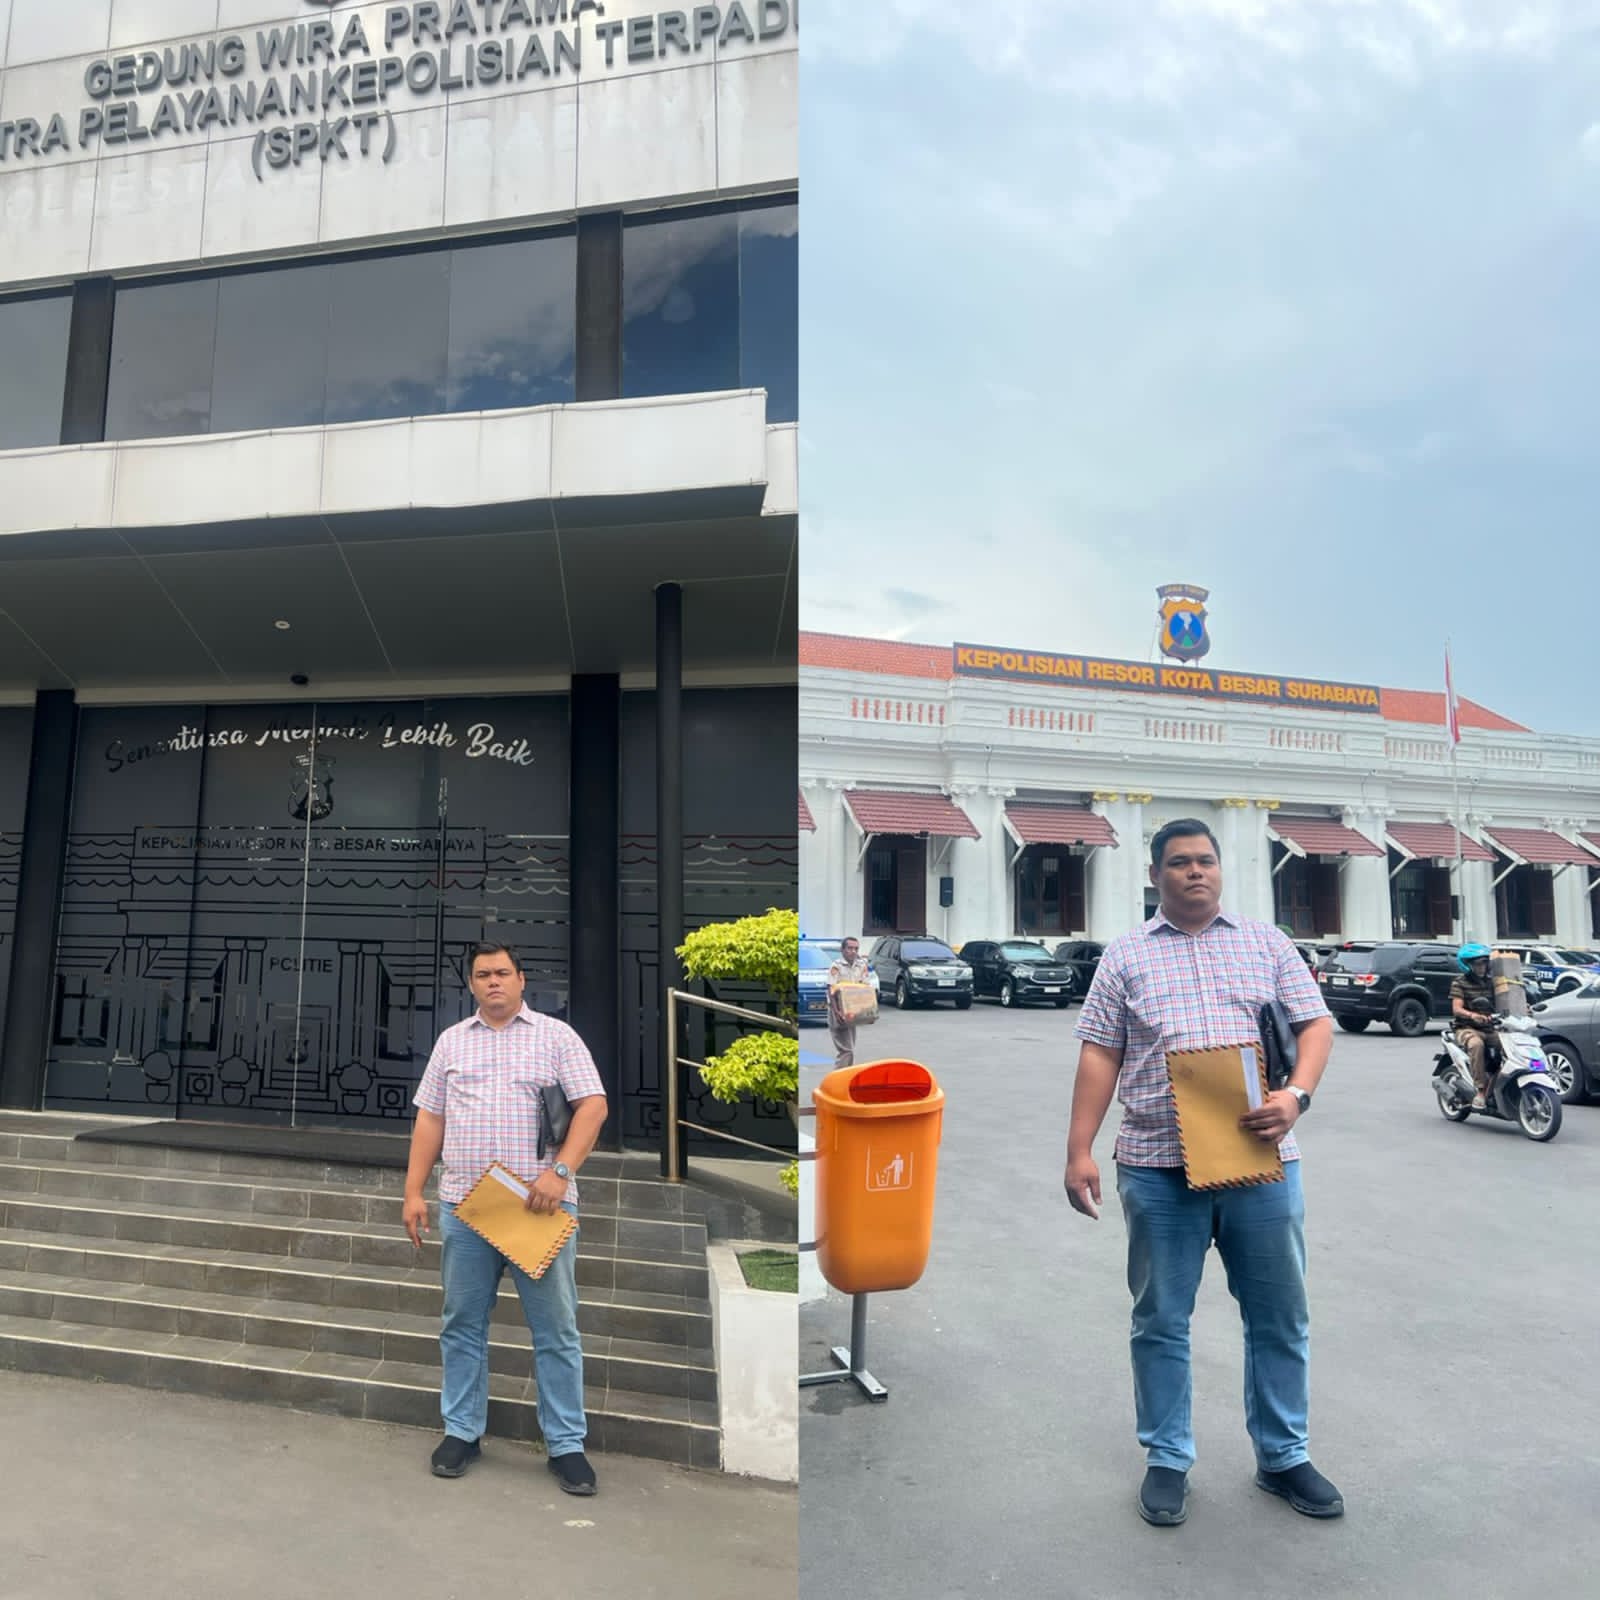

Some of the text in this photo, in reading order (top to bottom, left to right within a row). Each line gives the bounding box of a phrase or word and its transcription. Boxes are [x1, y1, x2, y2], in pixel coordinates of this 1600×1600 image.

[84, 35, 245, 99] GEDUNG
[256, 14, 371, 70] WIRA
[596, 0, 799, 65] TERPAD
[251, 110, 398, 182] (SPKT)
[957, 646, 1379, 706] KEPOLISIAN RESOR KOTA BESAR SURABAYA
[378, 711, 458, 748] Lebih
[465, 722, 536, 767] Baik
[334, 837, 387, 851] BESAR
